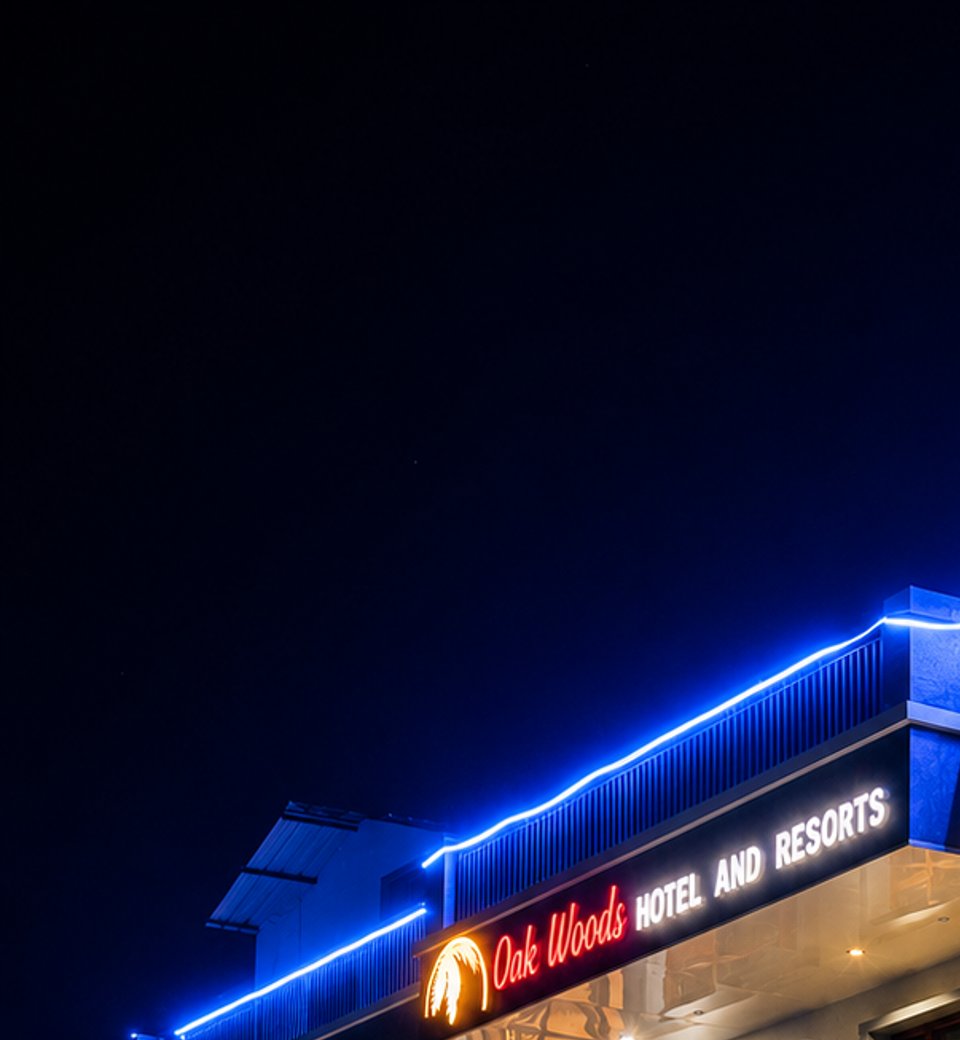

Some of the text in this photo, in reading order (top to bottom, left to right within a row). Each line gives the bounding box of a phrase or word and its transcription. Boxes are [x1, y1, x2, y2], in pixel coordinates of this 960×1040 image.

[492, 787, 886, 991] Oak Woods HOTEL AND RESORTS
